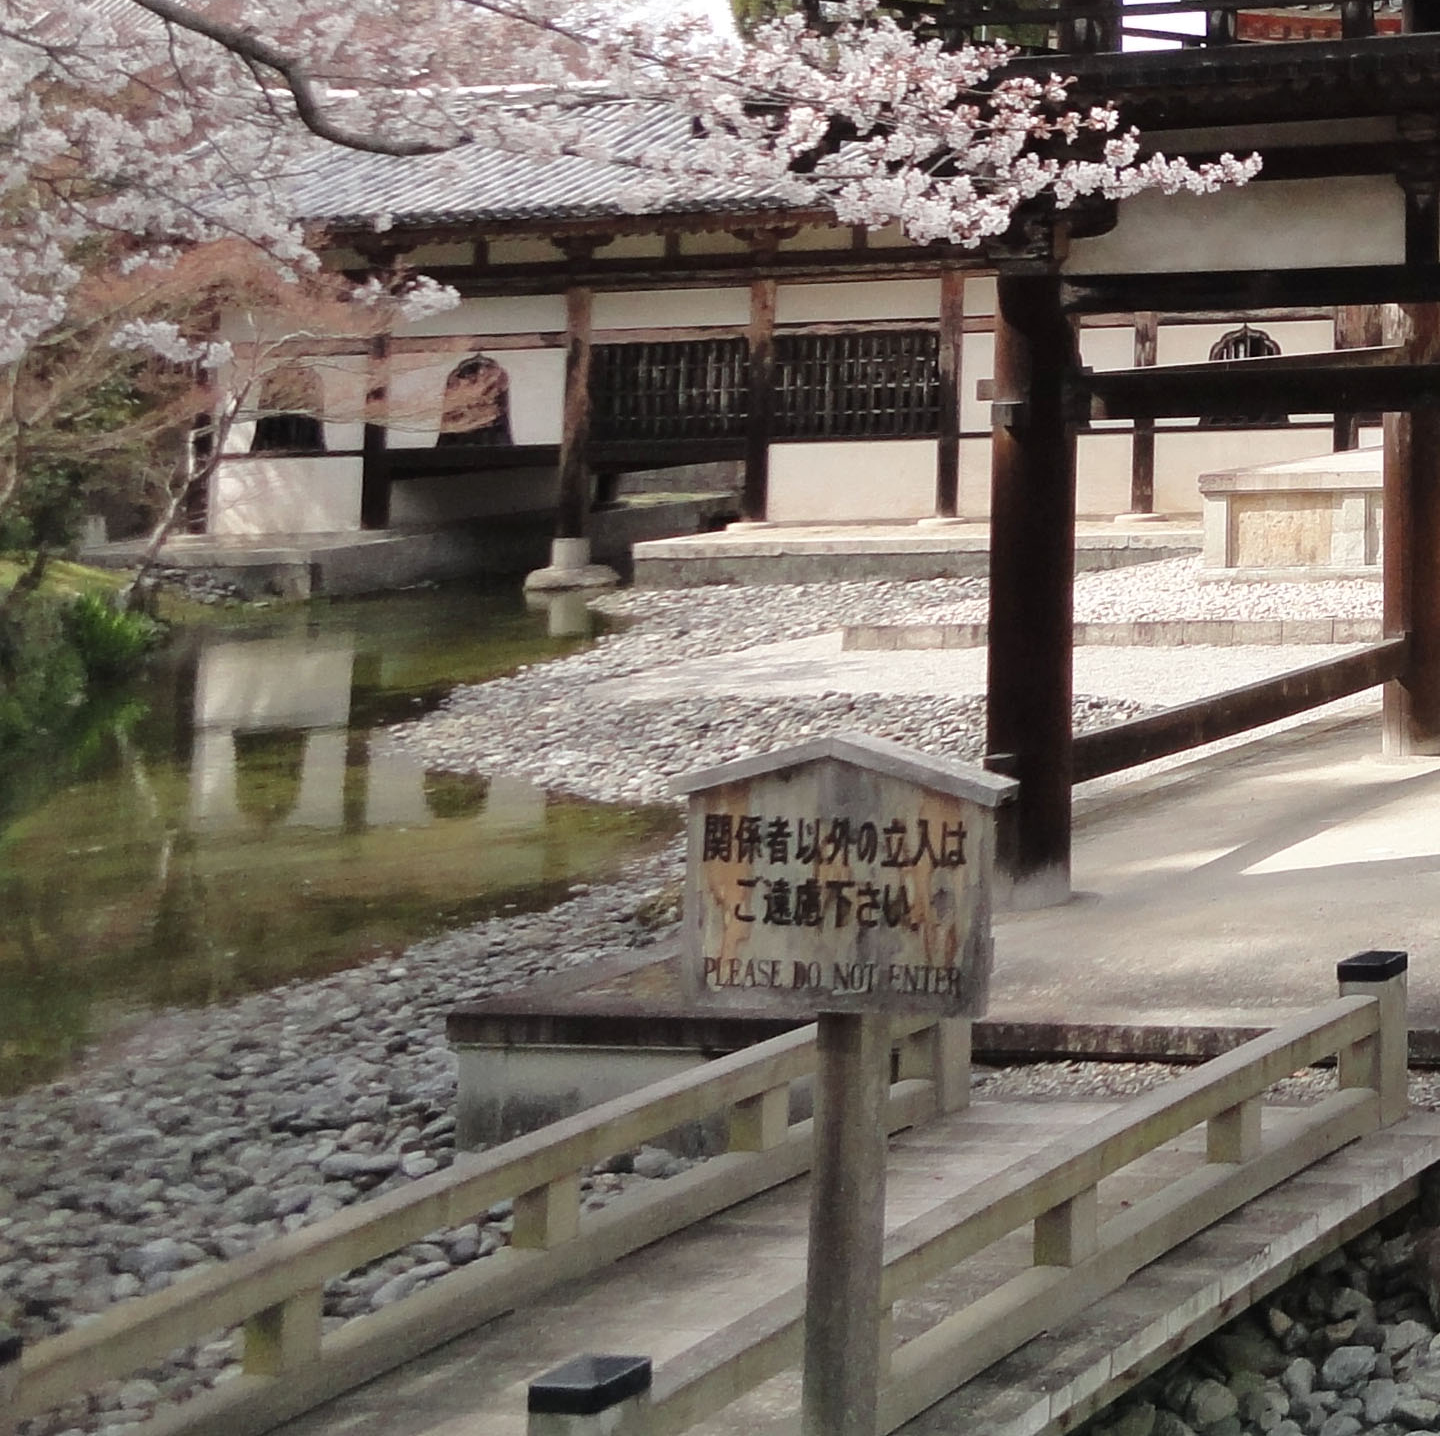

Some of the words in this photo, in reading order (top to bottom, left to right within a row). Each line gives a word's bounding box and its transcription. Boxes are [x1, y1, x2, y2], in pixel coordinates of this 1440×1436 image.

[703, 813, 968, 868] 関係者以外の立入は
[703, 956, 784, 991] PLEASE
[793, 961, 822, 990] DO
[832, 962, 878, 992] NOT
[890, 964, 962, 997] ENTER
